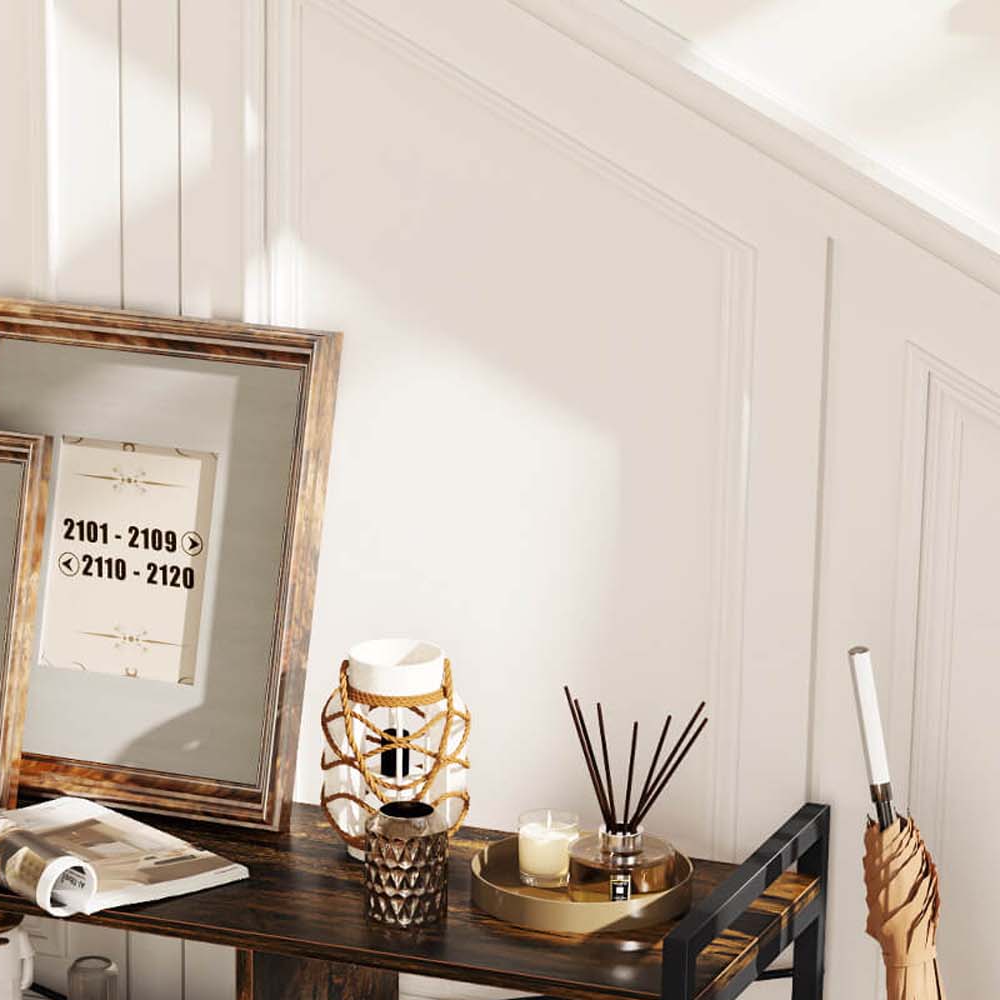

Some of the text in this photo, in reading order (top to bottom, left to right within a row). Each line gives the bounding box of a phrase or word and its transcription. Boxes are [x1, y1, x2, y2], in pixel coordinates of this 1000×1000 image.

[63, 518, 109, 545] 2101
[127, 525, 177, 552] 2109
[82, 554, 127, 581] 2110
[146, 562, 195, 590] 2120
